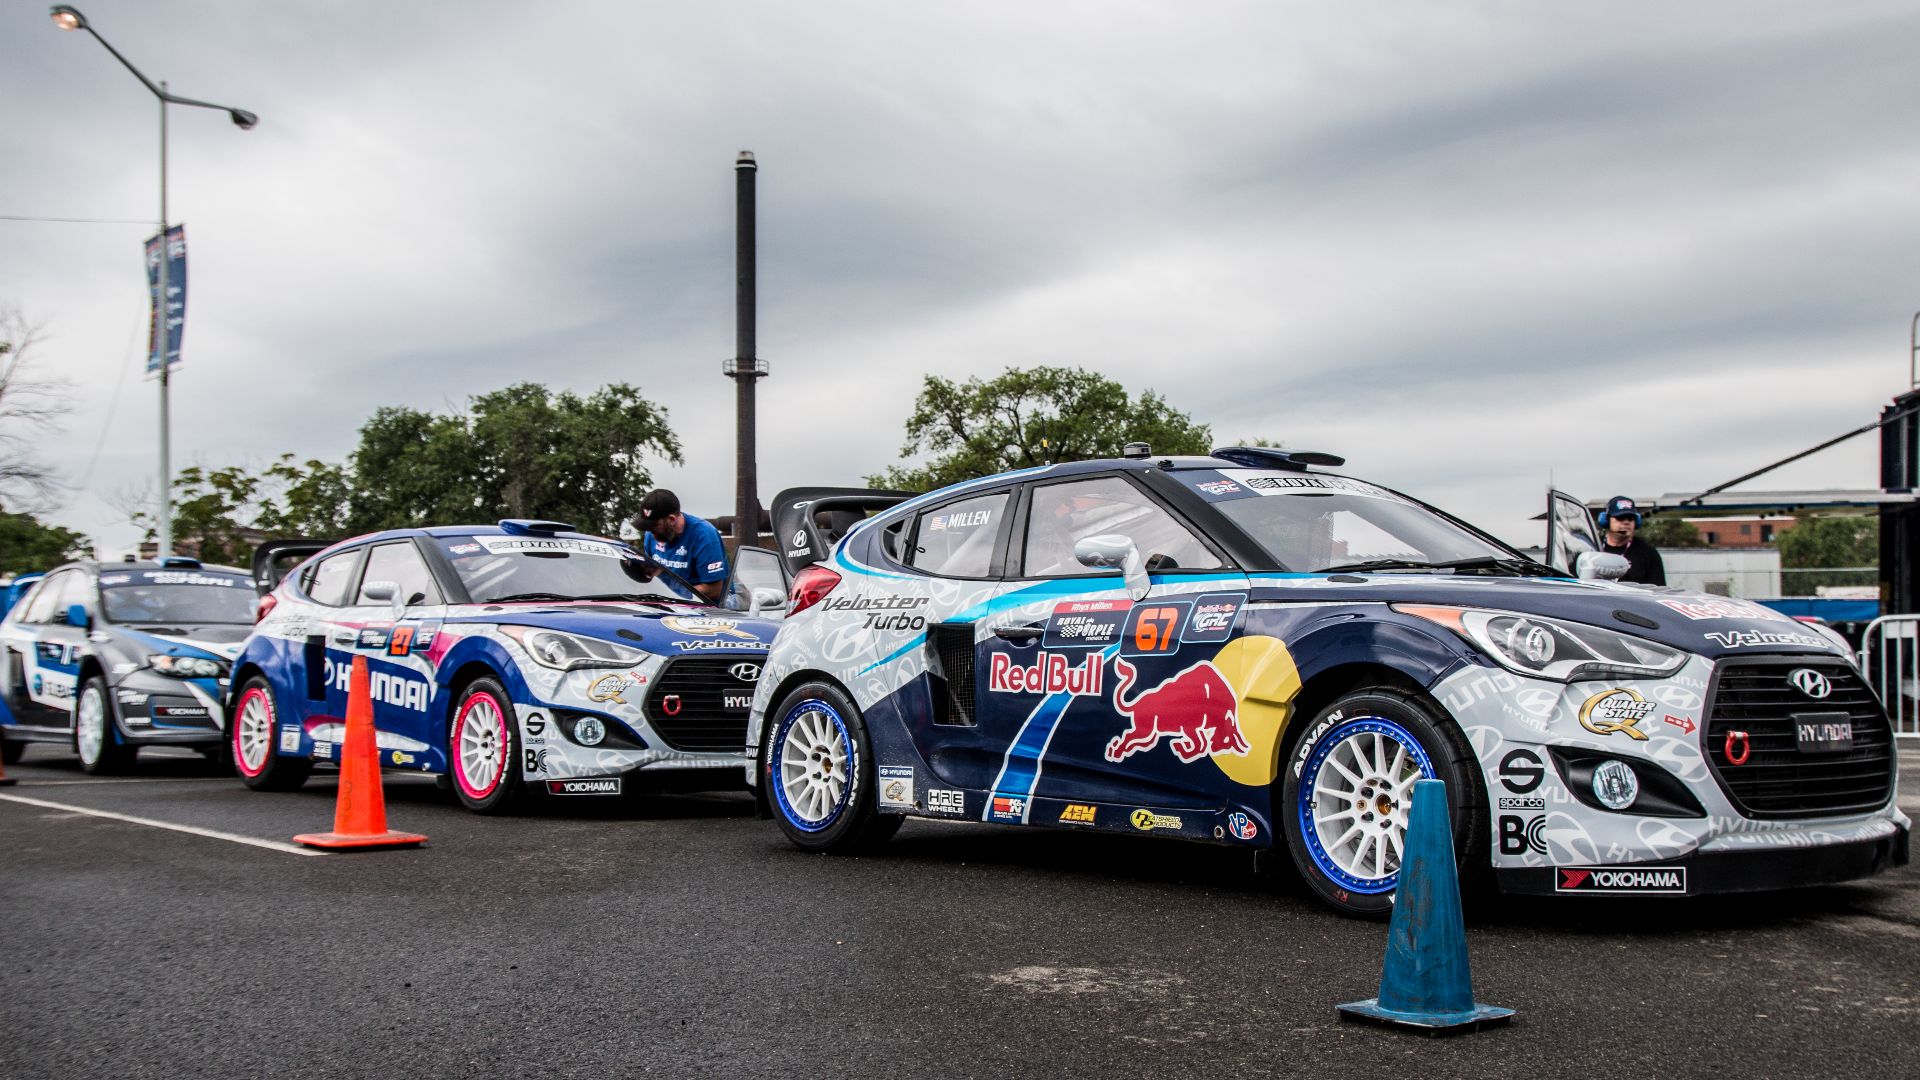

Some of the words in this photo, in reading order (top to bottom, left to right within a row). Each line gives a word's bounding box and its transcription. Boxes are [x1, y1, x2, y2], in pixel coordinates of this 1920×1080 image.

[947, 511, 990, 528] MILLEN
[512, 541, 559, 549] ROYAL
[788, 547, 811, 558] HYUNDAI
[821, 594, 929, 612] Veloster
[1071, 603, 1090, 612] Rhys
[1090, 602, 1113, 610] Millen
[862, 612, 925, 631] Turbo
[1057, 617, 1087, 626] ROYAL
[1198, 612, 1235, 627] GRC
[1075, 623, 1116, 637] PURPLE
[1135, 607, 1179, 651] 67
[391, 626, 414, 656] 27
[1703, 630, 1832, 649] Veloster
[990, 652, 1046, 693] Red
[1047, 654, 1104, 695] Bull
[336, 662, 429, 713] HUNDAI
[1599, 697, 1657, 712] QUAKER
[1604, 708, 1646, 720] STATE
[1798, 723, 1854, 742] HYUNDAI
[766, 723, 779, 765] YOKOHAMA
[1293, 709, 1344, 779] ADVAN
[564, 782, 616, 792] YOKOHAMA
[928, 789, 964, 806] HRE
[1500, 798, 1544, 809] sparco
[928, 805, 964, 814] WHEELS
[1060, 804, 1097, 822] AEM
[1229, 813, 1248, 838] VP
[1590, 872, 1680, 887] YOKOHAMA
